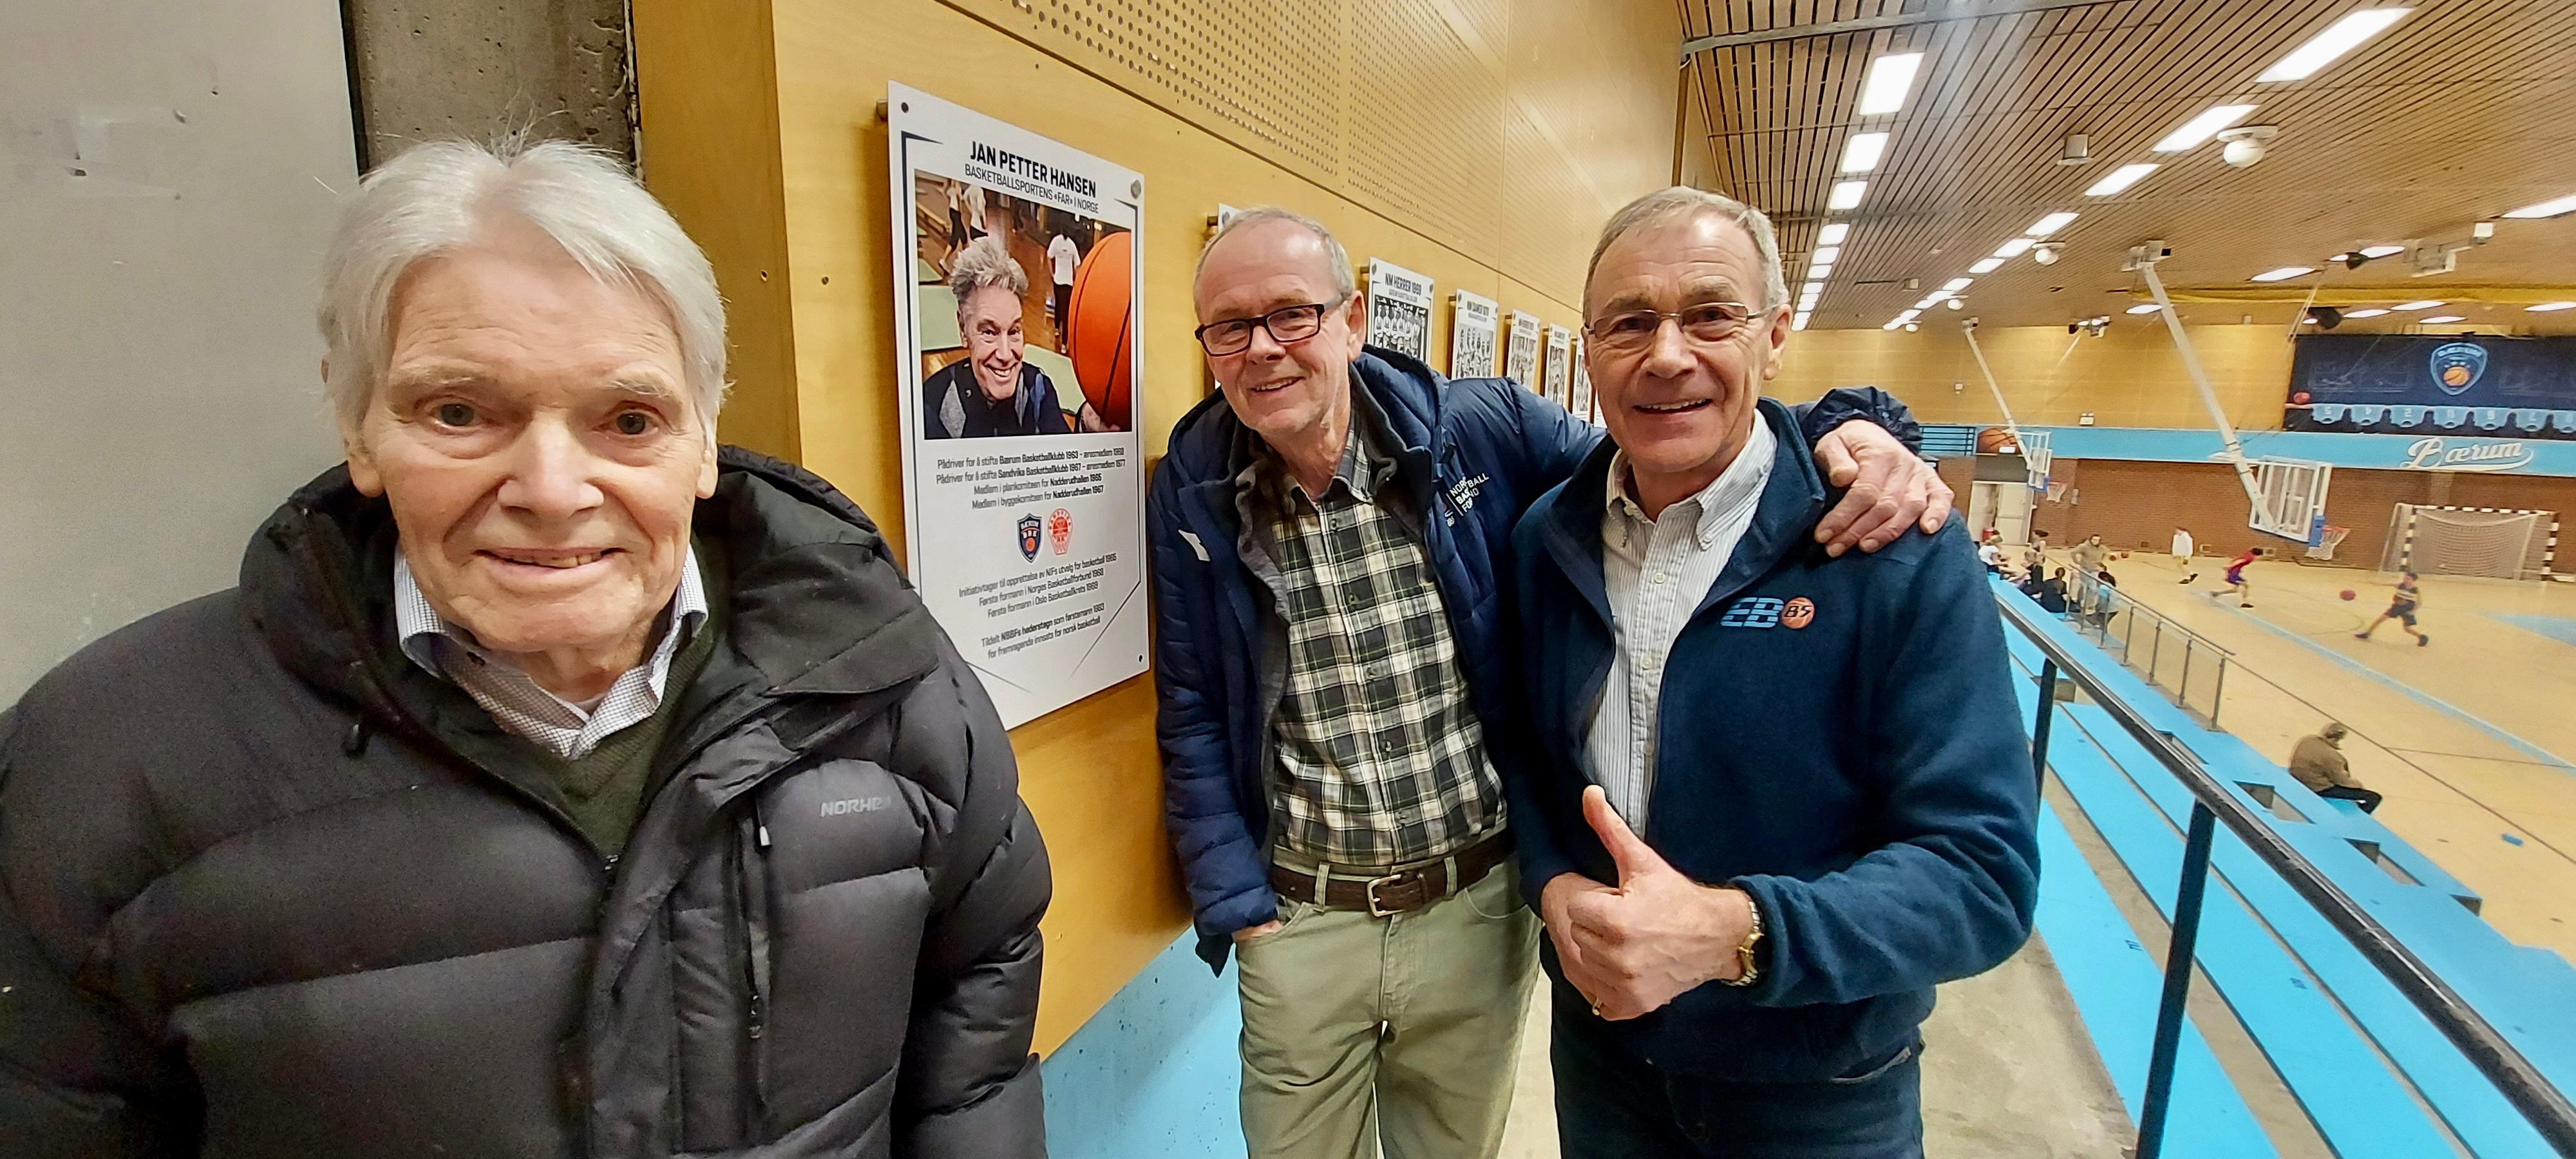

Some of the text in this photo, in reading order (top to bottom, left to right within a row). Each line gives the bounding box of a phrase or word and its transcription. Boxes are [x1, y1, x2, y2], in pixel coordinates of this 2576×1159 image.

[971, 141, 1096, 198] JAN PETTER HANSEN
[965, 163, 1053, 200] BASKETBALLSPORTENS
[1077, 198, 1099, 214] NORGE
[1385, 272, 1394, 287] NM
[1394, 275, 1411, 292] HERRER
[938, 458, 965, 469] Pådriver
[966, 457, 975, 467] for
[999, 455, 1021, 464] Bærum
[2400, 437, 2524, 469] Bærum
[936, 474, 963, 484] Pådriver
[965, 472, 974, 482] for
[974, 485, 998, 495] Medlem
[972, 499, 997, 509] Medlem
[1044, 491, 1052, 500] for
[1035, 595, 1047, 605] Oslo
[1054, 616, 1065, 626] som
[988, 649, 997, 659] for
[1063, 623, 1076, 635] norsk
